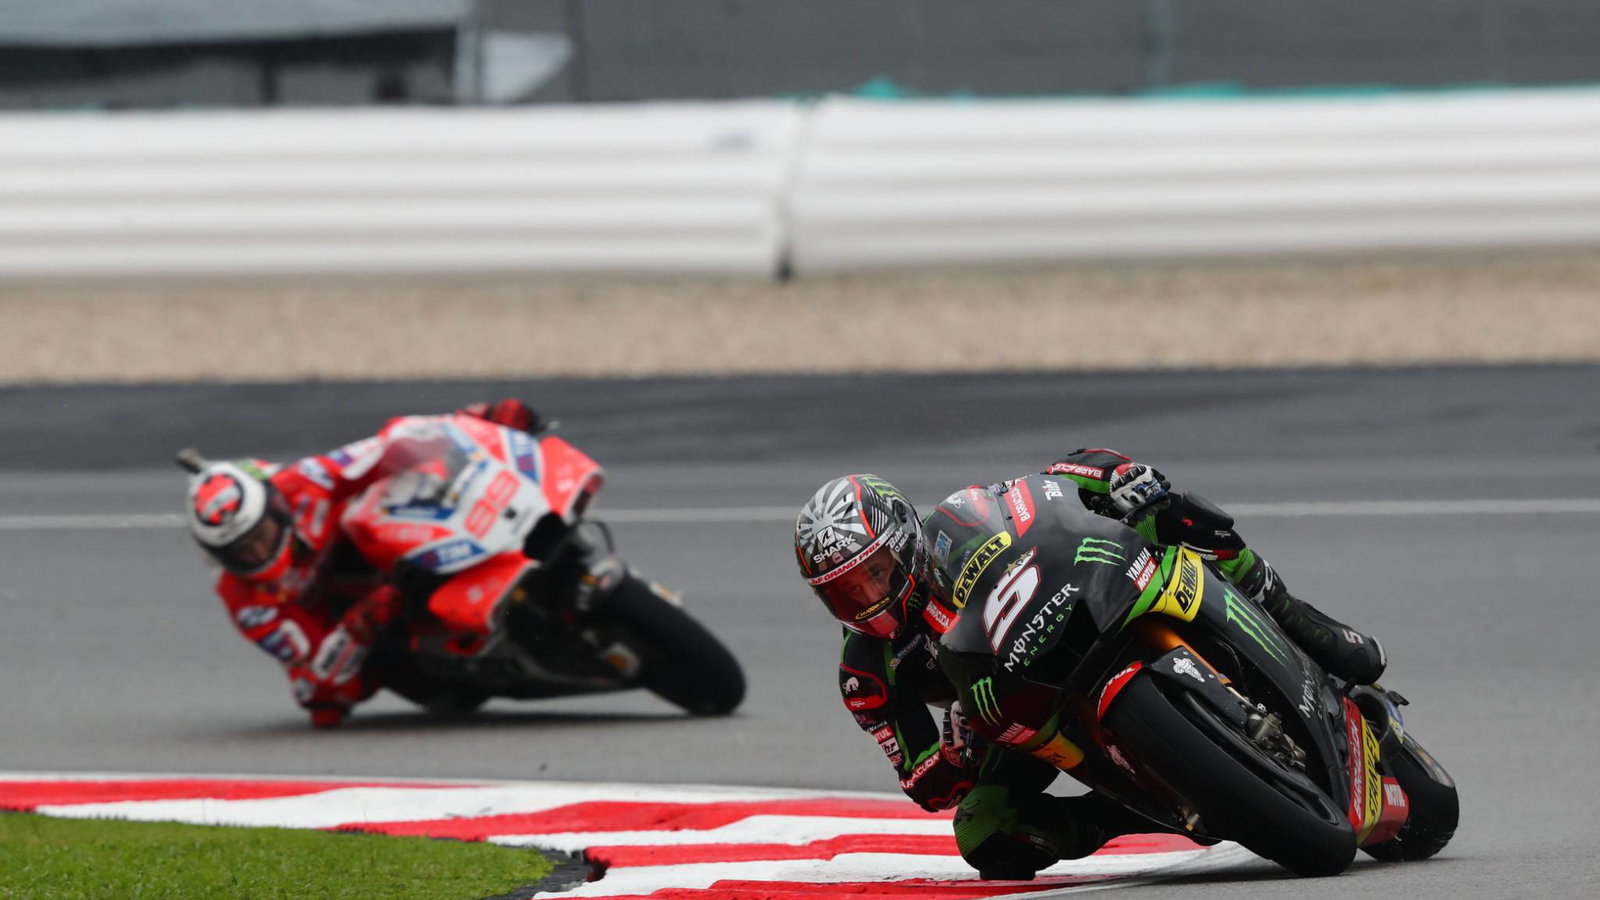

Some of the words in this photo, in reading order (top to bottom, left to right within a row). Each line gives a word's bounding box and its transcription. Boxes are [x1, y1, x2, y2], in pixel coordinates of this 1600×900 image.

[813, 534, 857, 564] SHARK
[824, 558, 857, 582] GRAND
[859, 541, 881, 562] PRIX
[956, 537, 1004, 602] DEWALT
[1125, 547, 1153, 581] YAMAHA
[1137, 560, 1158, 592] MOTUL
[981, 546, 1042, 657] 5
[1176, 553, 1198, 609] DEWALT
[1003, 583, 1080, 673] MONSTER
[1023, 603, 1073, 668] ENERGY
